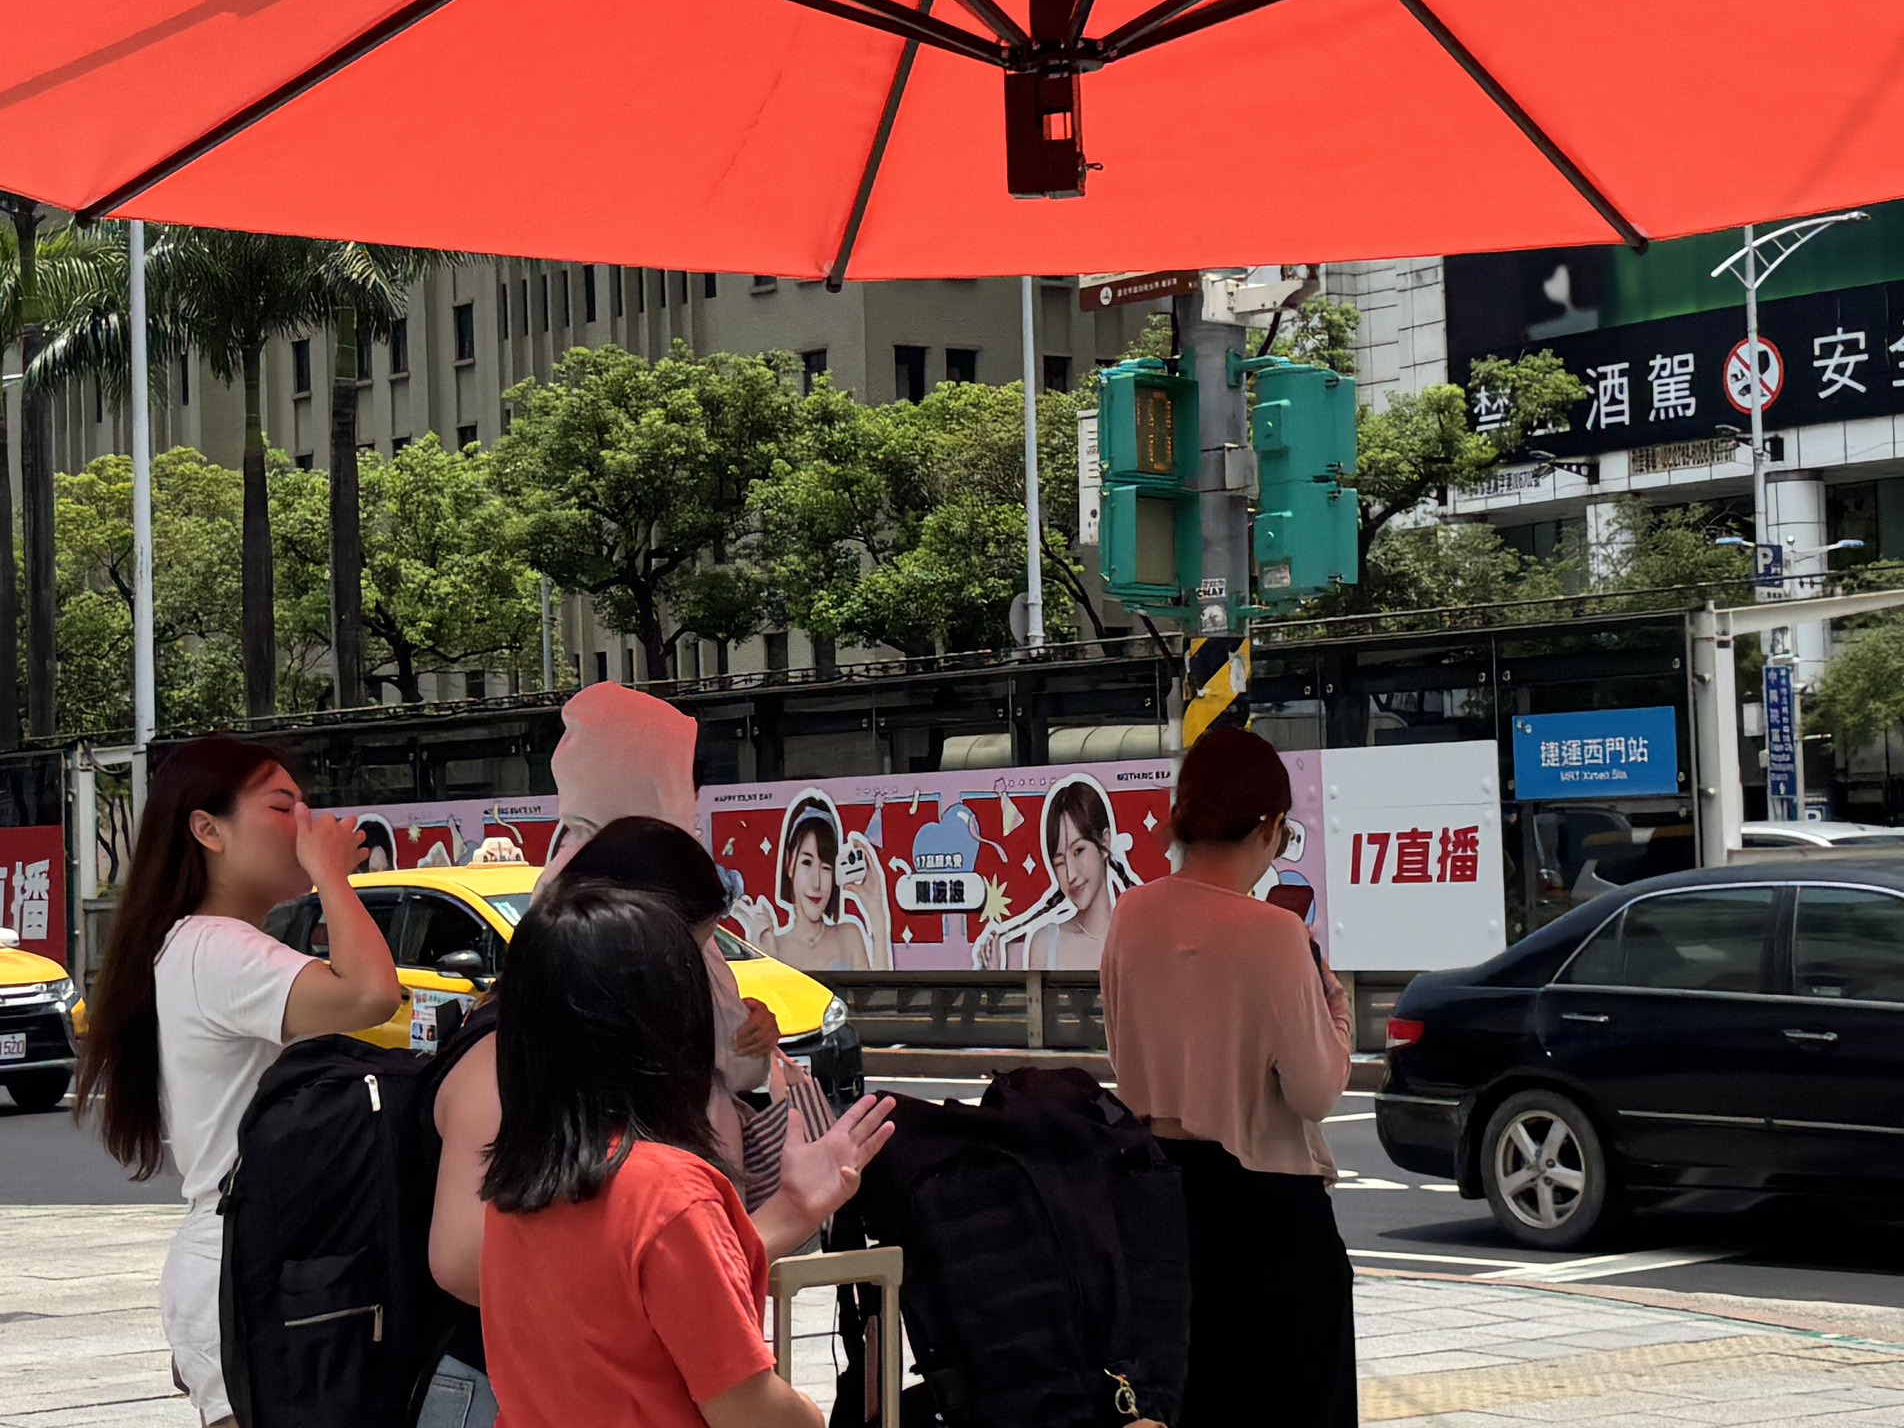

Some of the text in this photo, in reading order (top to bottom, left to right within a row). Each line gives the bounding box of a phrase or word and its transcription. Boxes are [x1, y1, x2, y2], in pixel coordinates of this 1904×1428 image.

[1473, 352, 1697, 435] 禁酒駕
[1540, 736, 1649, 767] 捷運西門站
[1350, 825, 1480, 885] 17直播
